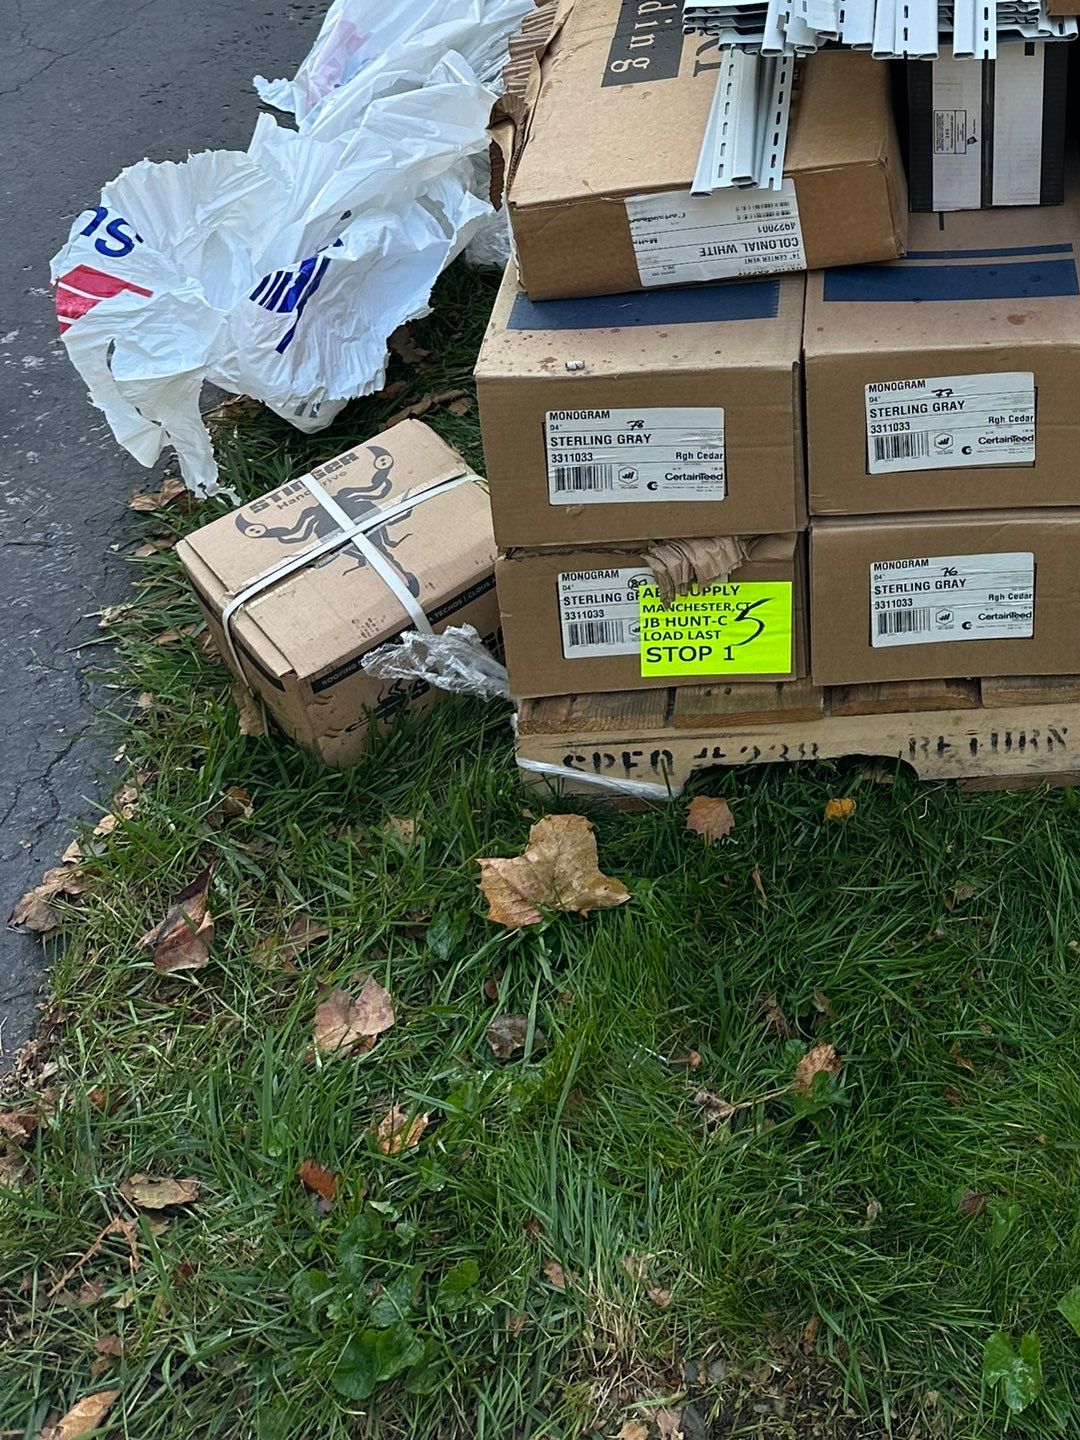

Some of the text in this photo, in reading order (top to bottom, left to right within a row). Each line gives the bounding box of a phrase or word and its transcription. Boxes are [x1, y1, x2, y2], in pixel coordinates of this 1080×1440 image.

[700, 237, 799, 257] COLONIAL WHITE
[868, 380, 926, 393] MONOGRAM
[550, 410, 610, 420] MONOGRAM
[870, 401, 965, 418] STERLING GRAY
[871, 422, 910, 434] 3311033
[551, 434, 651, 447] STERLING GRAY
[978, 435, 1034, 445] CertainTeed
[552, 453, 593, 463] 3311033
[676, 451, 723, 460] Rgh Cedar
[665, 472, 723, 481] CertainTeed
[874, 559, 929, 571] MONOGRAM
[562, 570, 619, 581] MONOGRAM
[680, 585, 740, 597] UPPLY
[874, 579, 967, 595] STERLING GRAY
[563, 593, 622, 606] STERLING
[875, 598, 913, 610] 3311033
[565, 610, 605, 620] 3311033
[978, 611, 1032, 621] CertainTeed
[643, 615, 728, 628] JB HUNT-C
[644, 630, 721, 641] LOAD LAST
[646, 646, 735, 663] STOP 1
